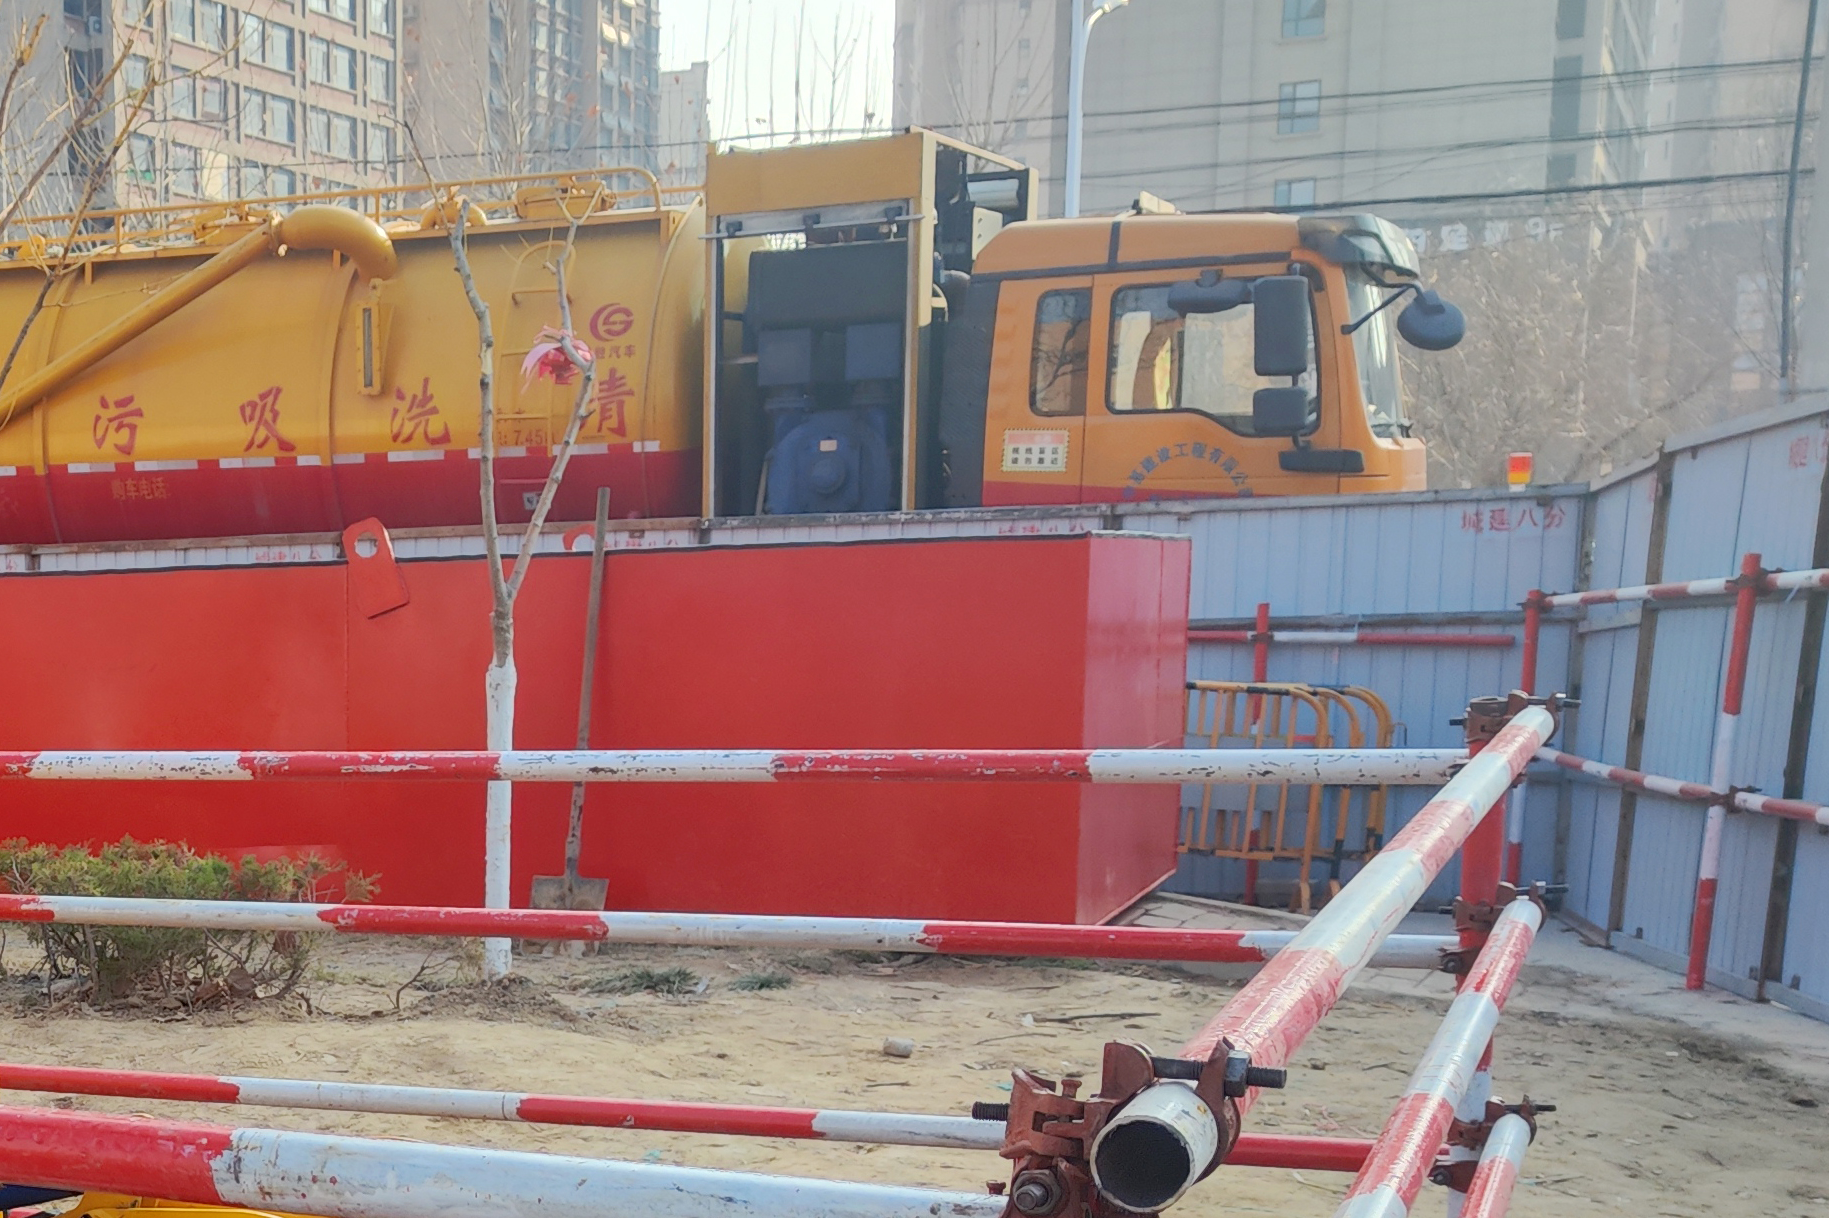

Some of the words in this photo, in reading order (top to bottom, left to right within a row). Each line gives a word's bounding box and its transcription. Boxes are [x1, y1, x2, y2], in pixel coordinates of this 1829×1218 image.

[93, 394, 144, 456] 污
[239, 386, 297, 452] 吸
[390, 376, 452, 446] 洗
